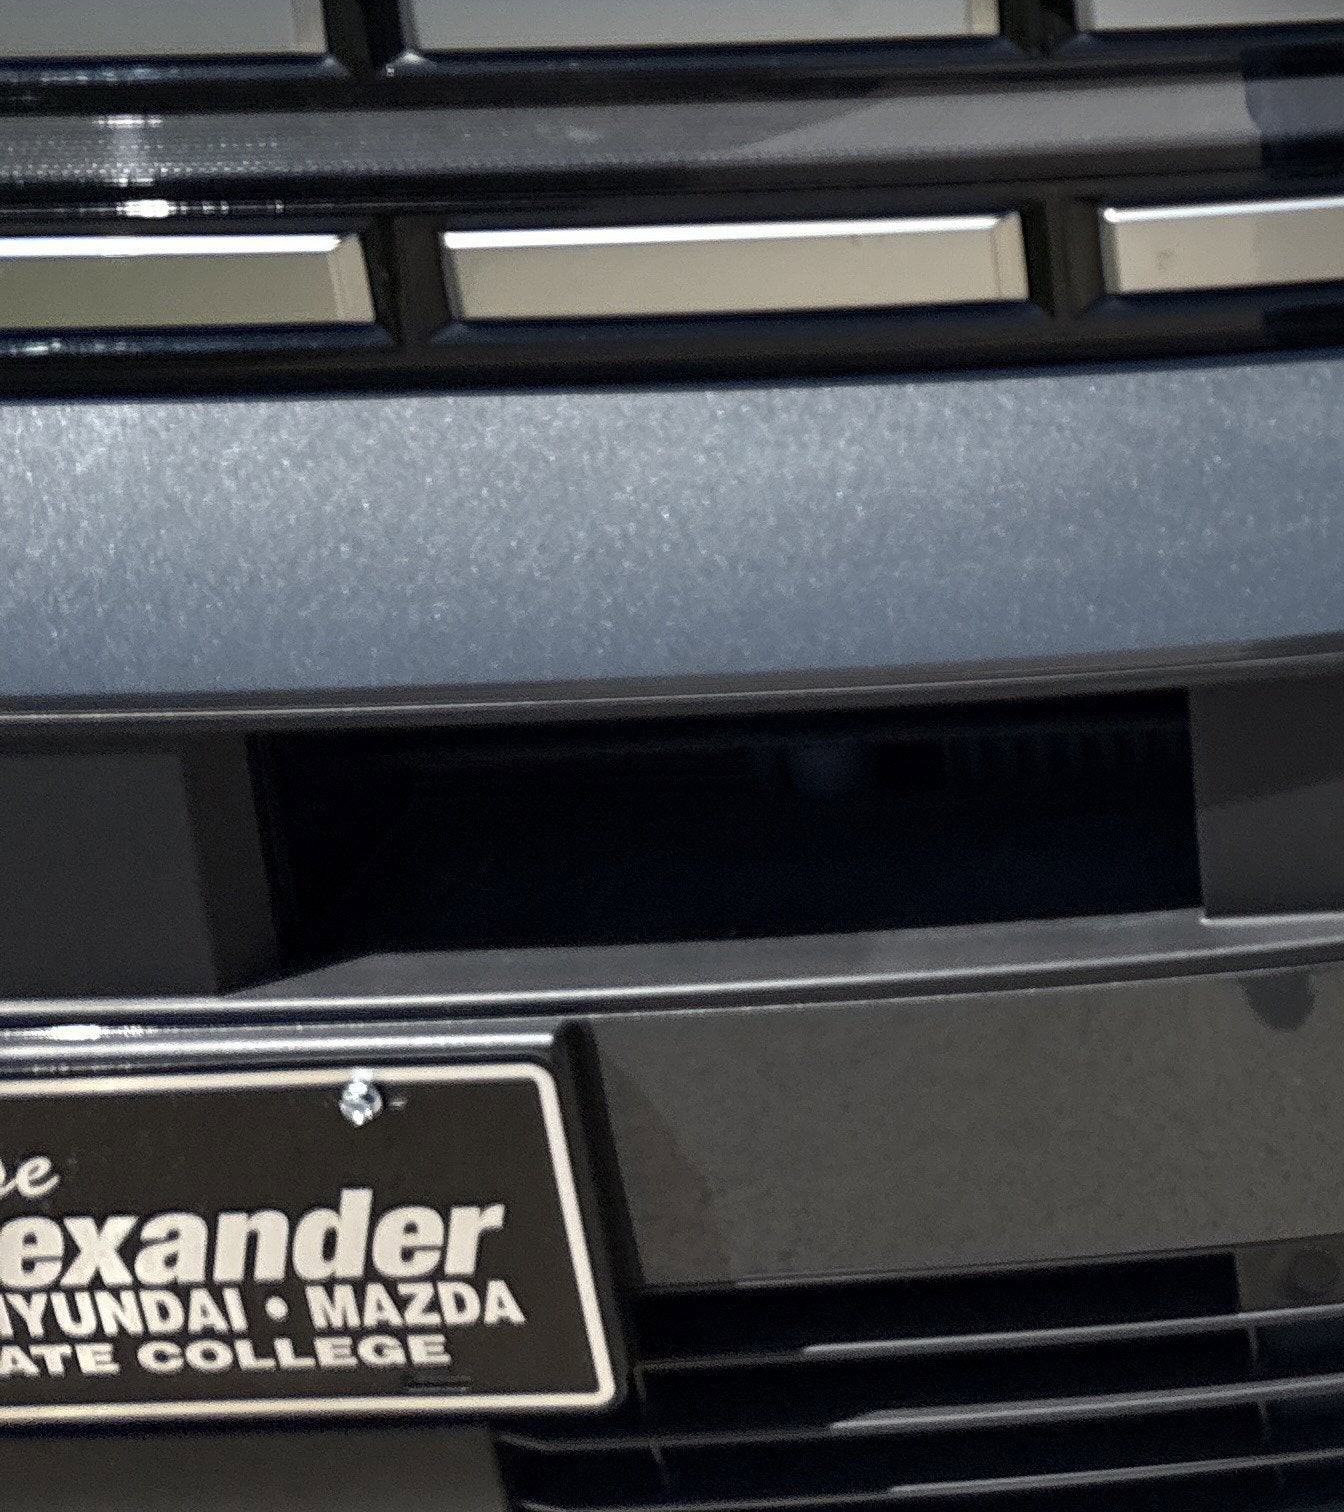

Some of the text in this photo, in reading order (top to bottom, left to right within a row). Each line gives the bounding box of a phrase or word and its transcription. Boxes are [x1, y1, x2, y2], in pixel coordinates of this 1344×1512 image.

[0, 1155, 62, 1199] e
[0, 1188, 505, 1289] exander
[308, 1280, 527, 1330] MAZDA
[136, 1333, 452, 1374] COLLEGE
